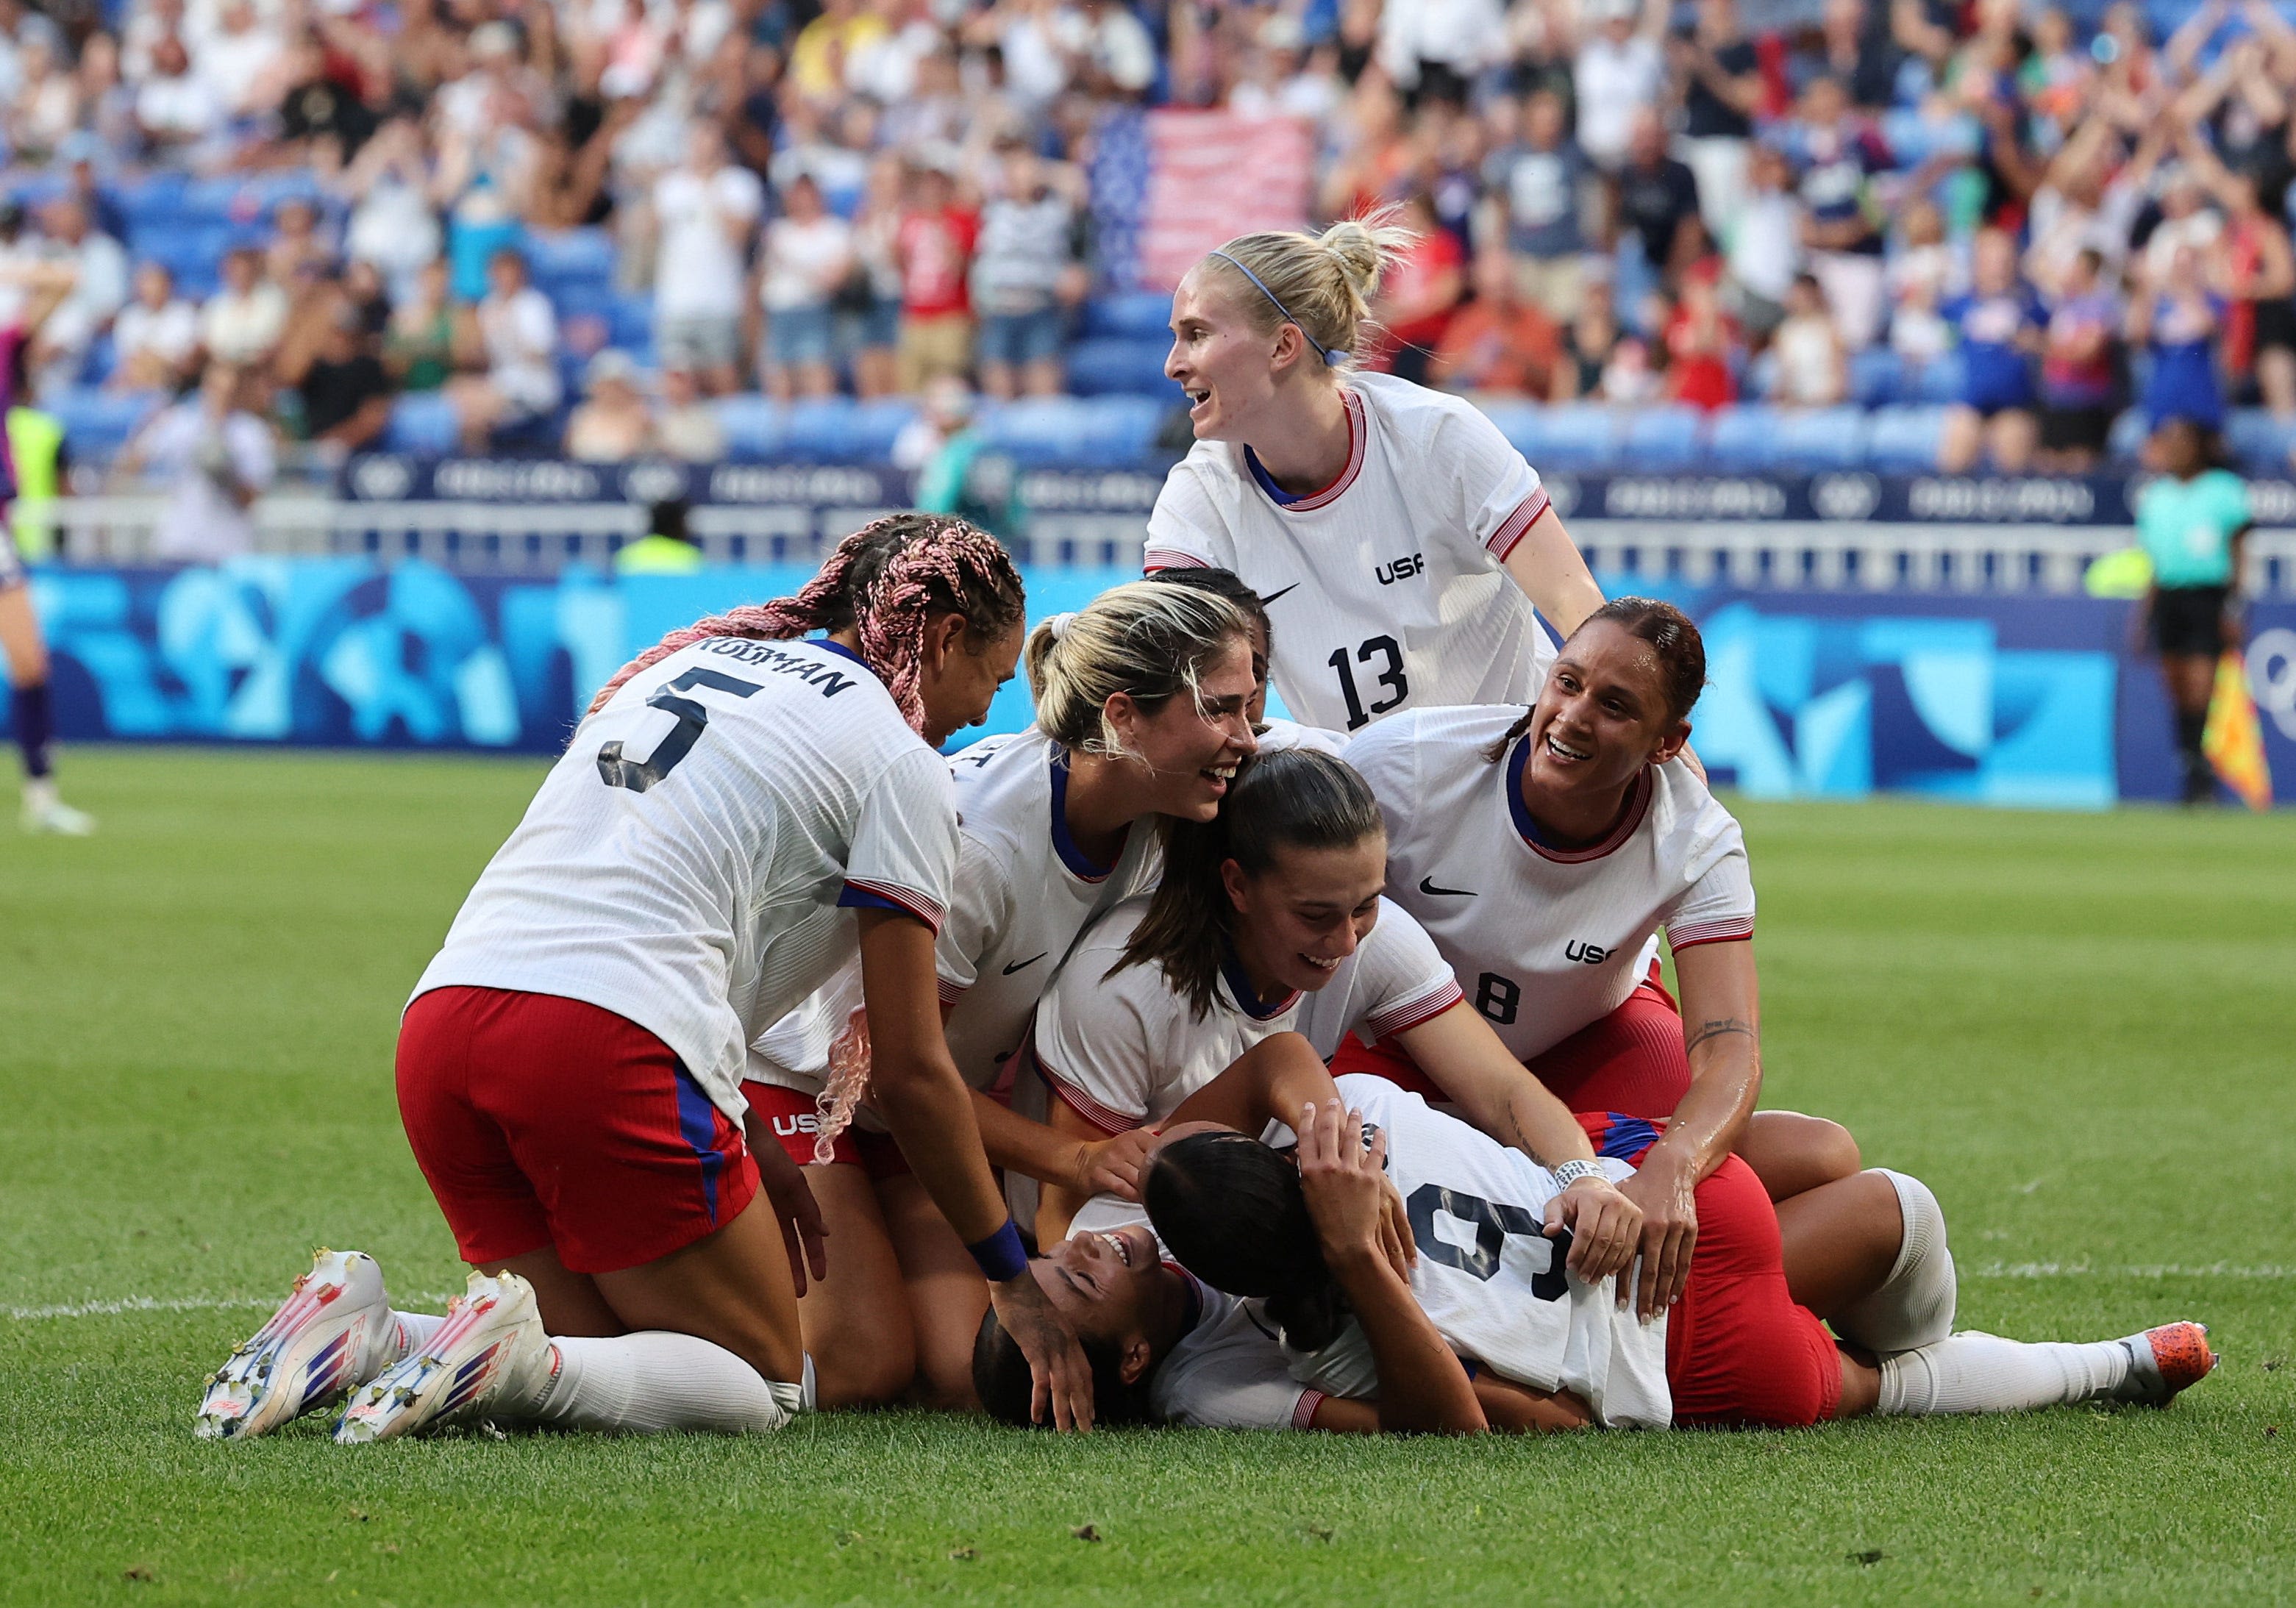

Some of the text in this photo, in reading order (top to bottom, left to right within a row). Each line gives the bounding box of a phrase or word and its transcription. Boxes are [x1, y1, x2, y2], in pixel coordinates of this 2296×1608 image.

[596, 666, 766, 793] 5
[1328, 634, 1409, 732] 13
[1475, 971, 1521, 1025] 8
[773, 1113, 821, 1137] US
[1406, 1182, 1574, 1303] 9
